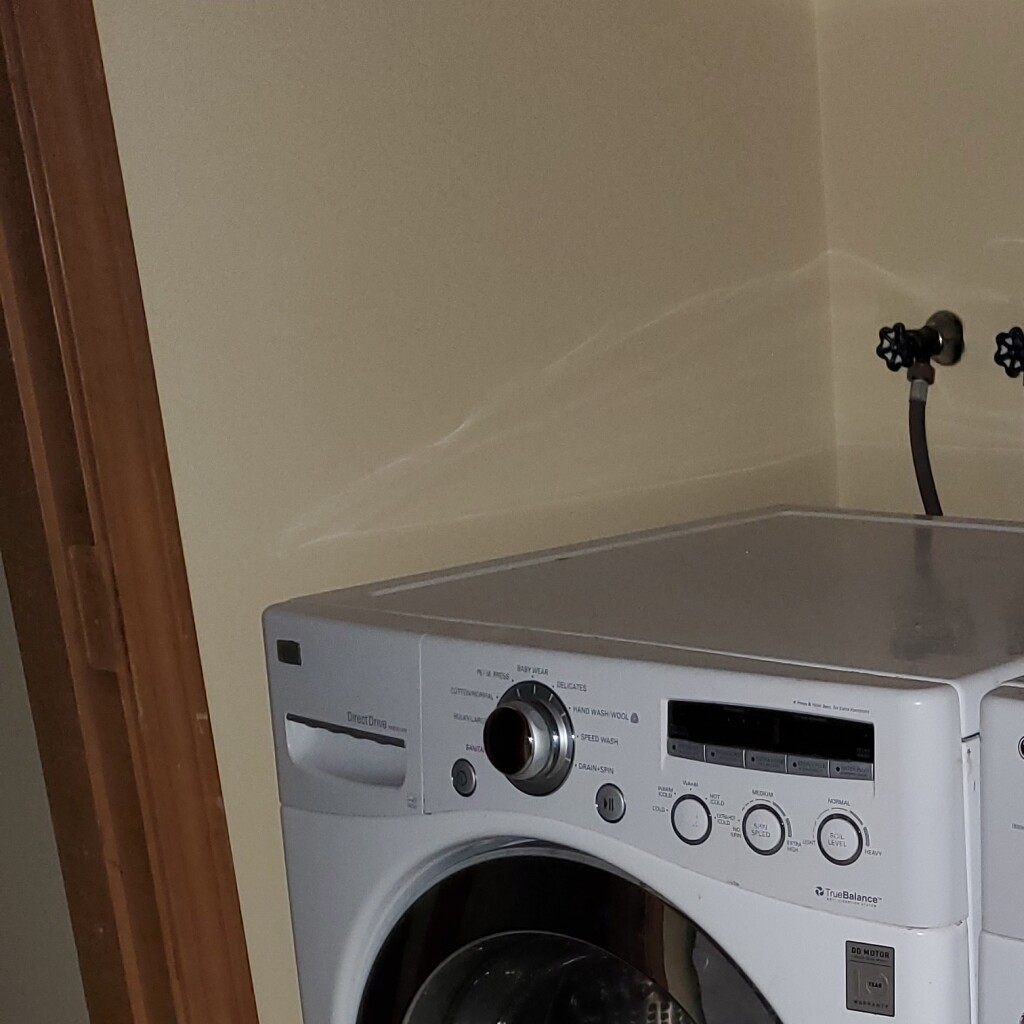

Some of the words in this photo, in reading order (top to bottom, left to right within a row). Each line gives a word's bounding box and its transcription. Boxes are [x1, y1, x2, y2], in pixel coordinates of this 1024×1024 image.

[557, 681, 587, 692] DELICATES
[573, 706, 590, 715] HAND
[581, 733, 599, 743] SPEED
[601, 736, 619, 745] WASH
[828, 797, 851, 807] NORMAL
[828, 839, 847, 848] LEVEL
[865, 849, 882, 857] HEAVY
[863, 948, 890, 959] MOTOR
